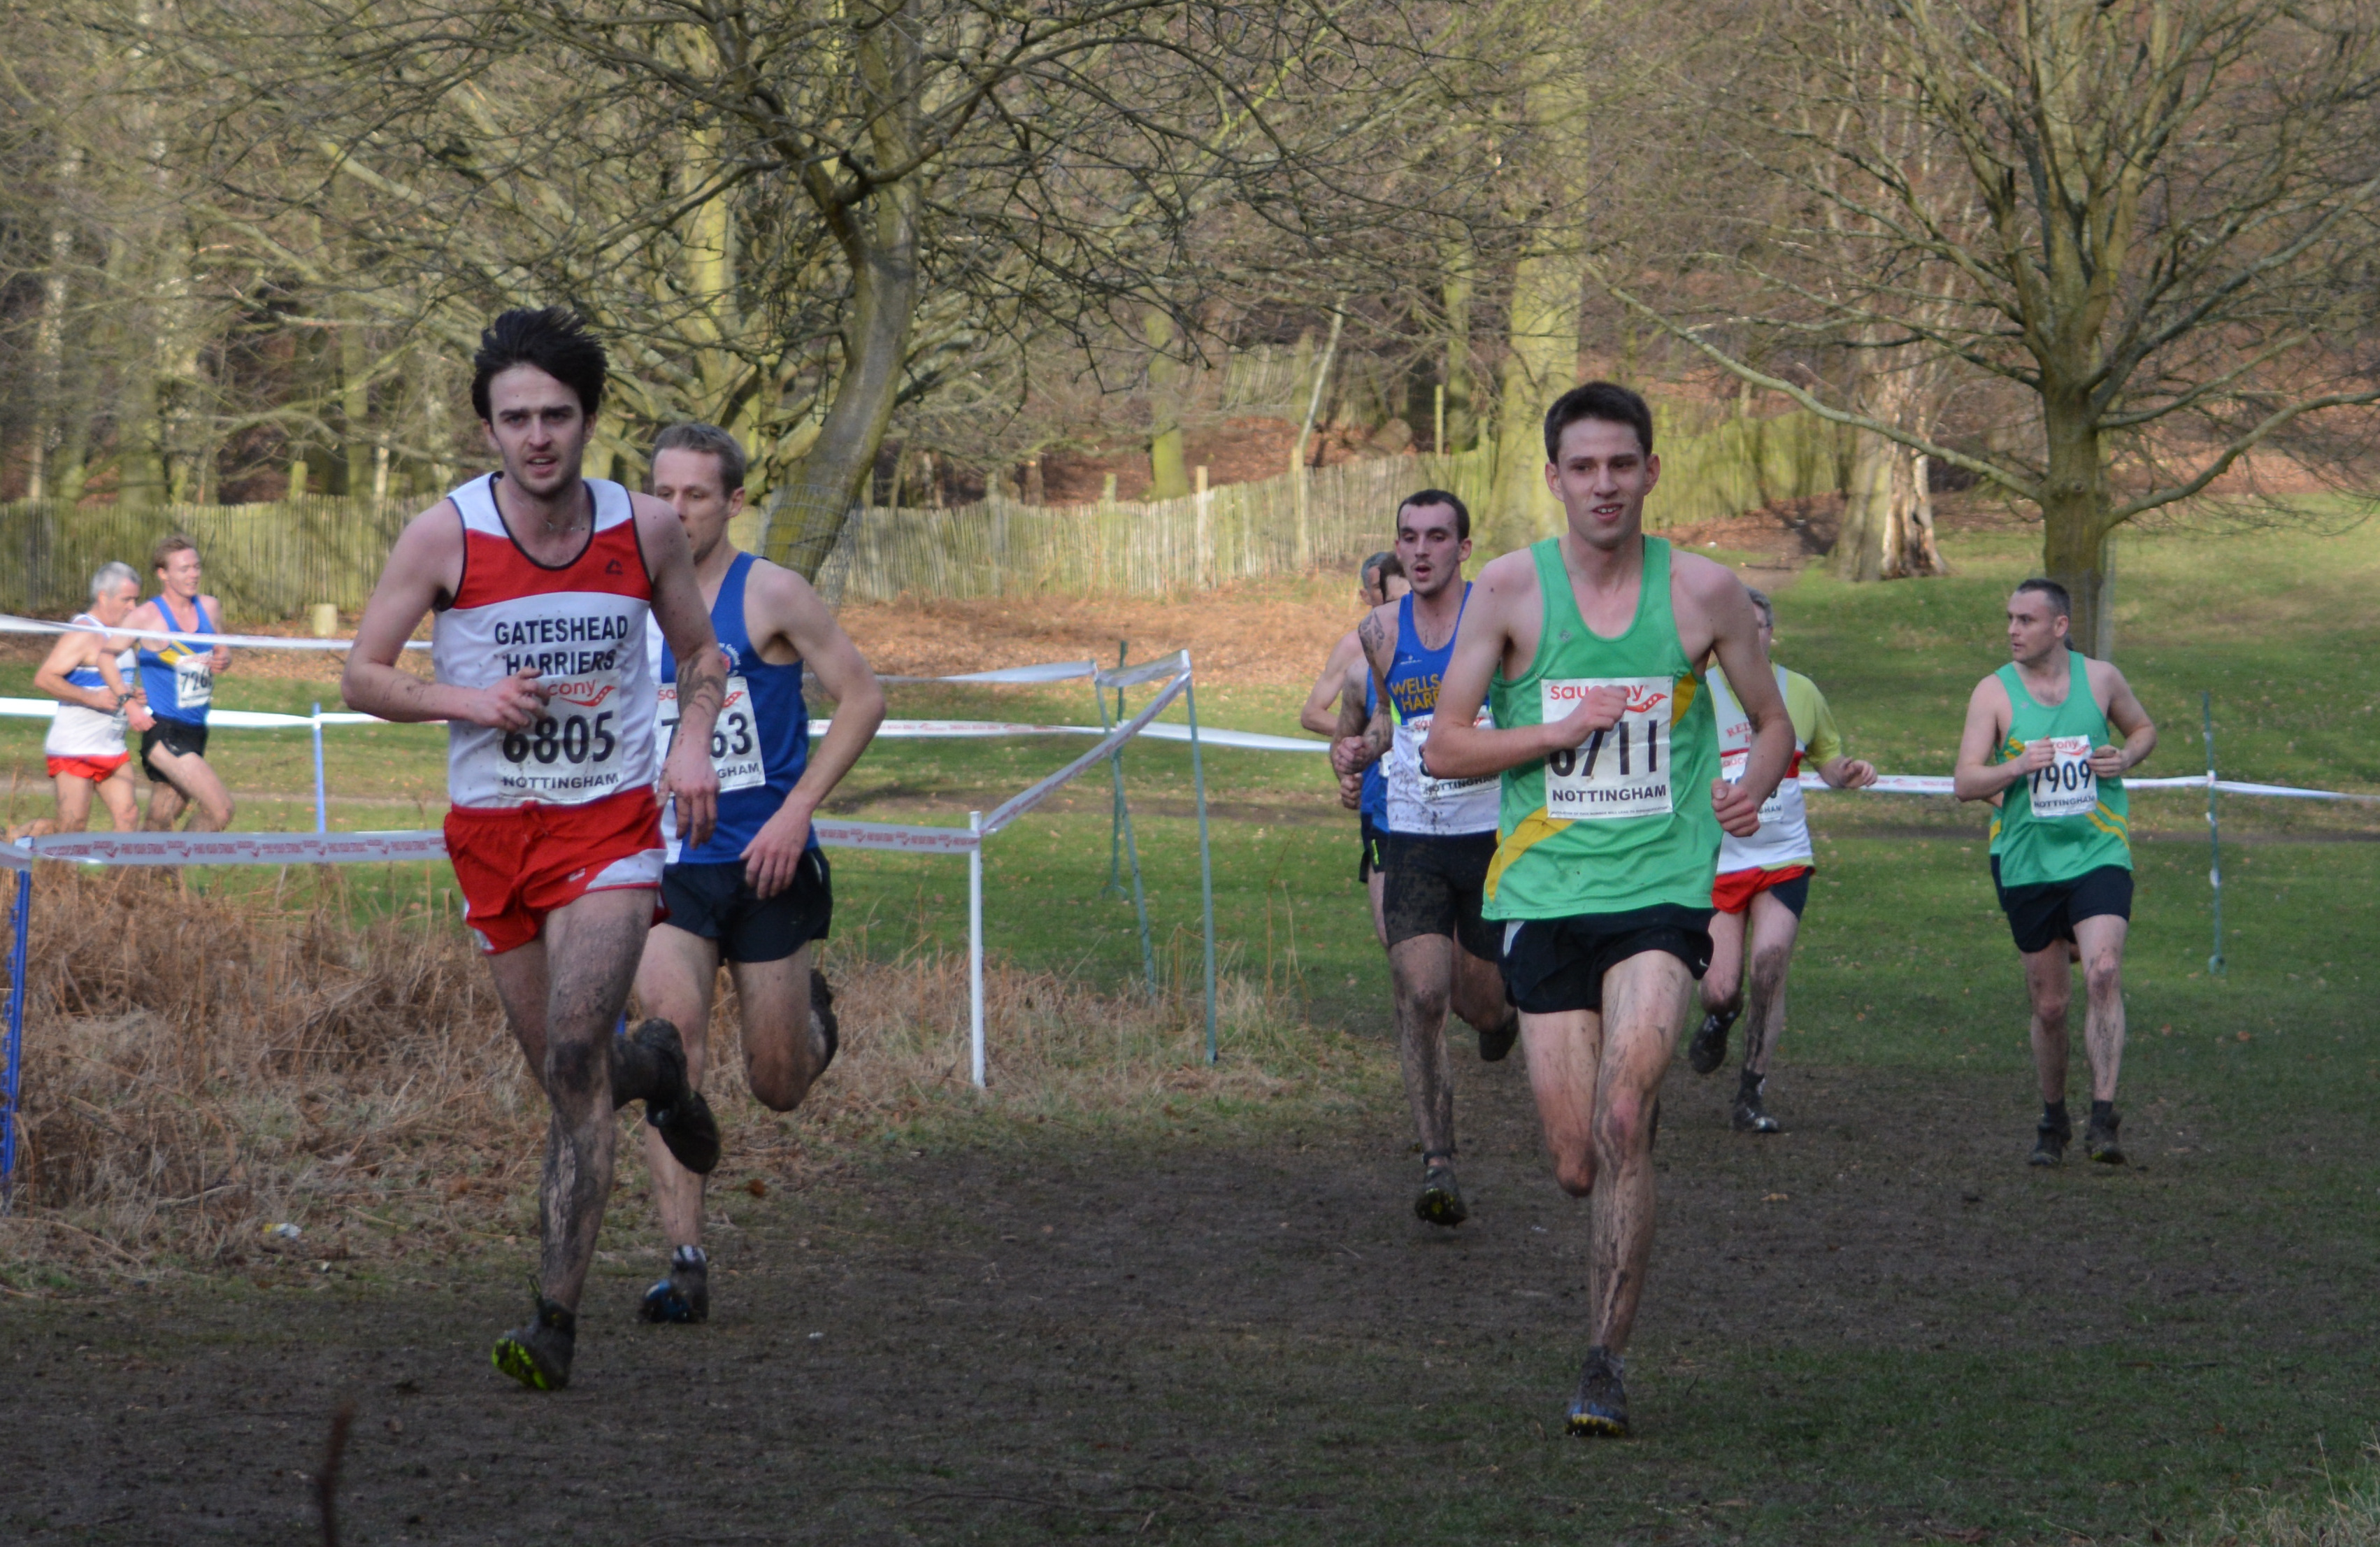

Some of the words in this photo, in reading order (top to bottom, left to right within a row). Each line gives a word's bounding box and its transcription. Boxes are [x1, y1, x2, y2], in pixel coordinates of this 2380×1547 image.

[495, 615, 629, 645] GATESHEAD
[507, 649, 617, 676] HARRIERS
[547, 679, 596, 697] cony
[1551, 685, 1644, 701] sauy
[503, 711, 615, 764] 6805
[661, 712, 752, 761] 763
[503, 773, 619, 790] NOTTINGHAM
[2033, 760, 2092, 794] 7909
[1552, 785, 1666, 802] NOTTINGHAM
[2034, 796, 2095, 808] NOTTINGHAM
